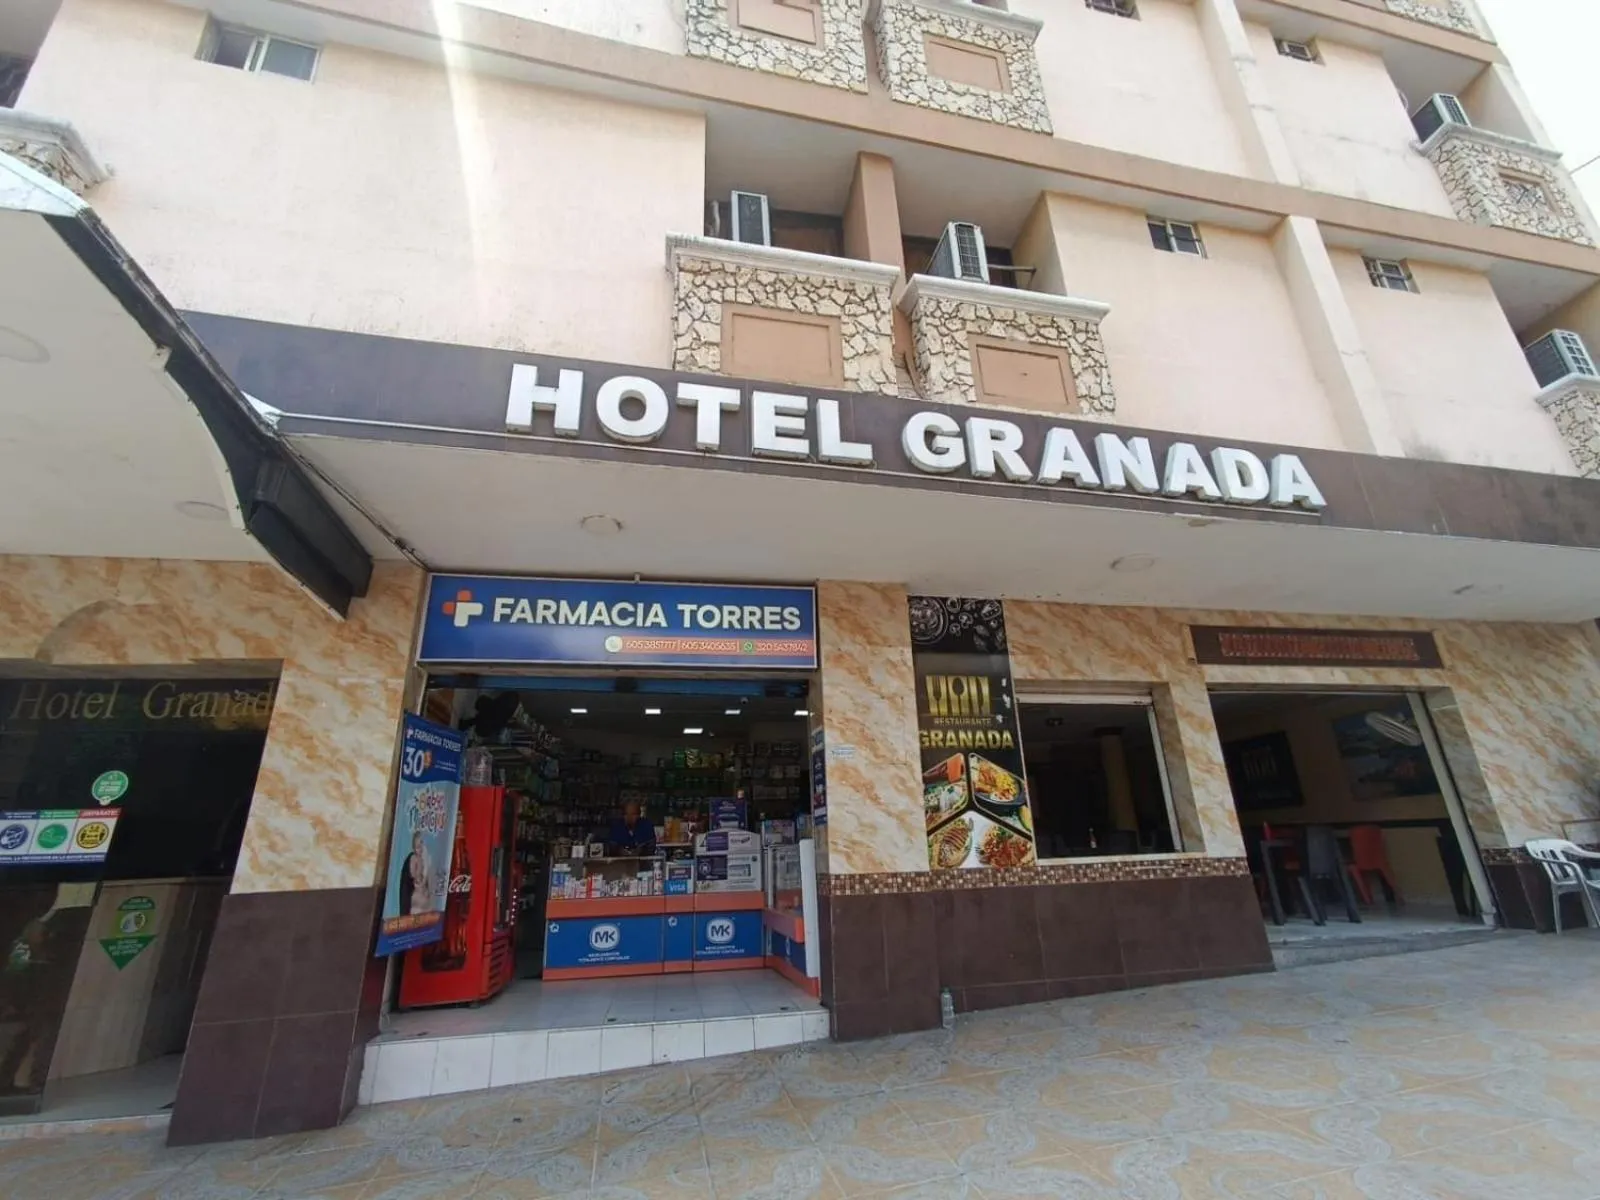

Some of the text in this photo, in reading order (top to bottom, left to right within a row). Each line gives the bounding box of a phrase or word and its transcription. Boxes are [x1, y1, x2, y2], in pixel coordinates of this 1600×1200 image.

[504, 364, 1327, 509] HOTEL GRANADA
[493, 597, 801, 631] FARMACIA TORRES
[9, 681, 121, 720] Hotel
[934, 717, 992, 726] RESTAURANTE
[918, 729, 1015, 749] GRANADA
[594, 930, 616, 944] MK
[710, 924, 730, 938] MK
